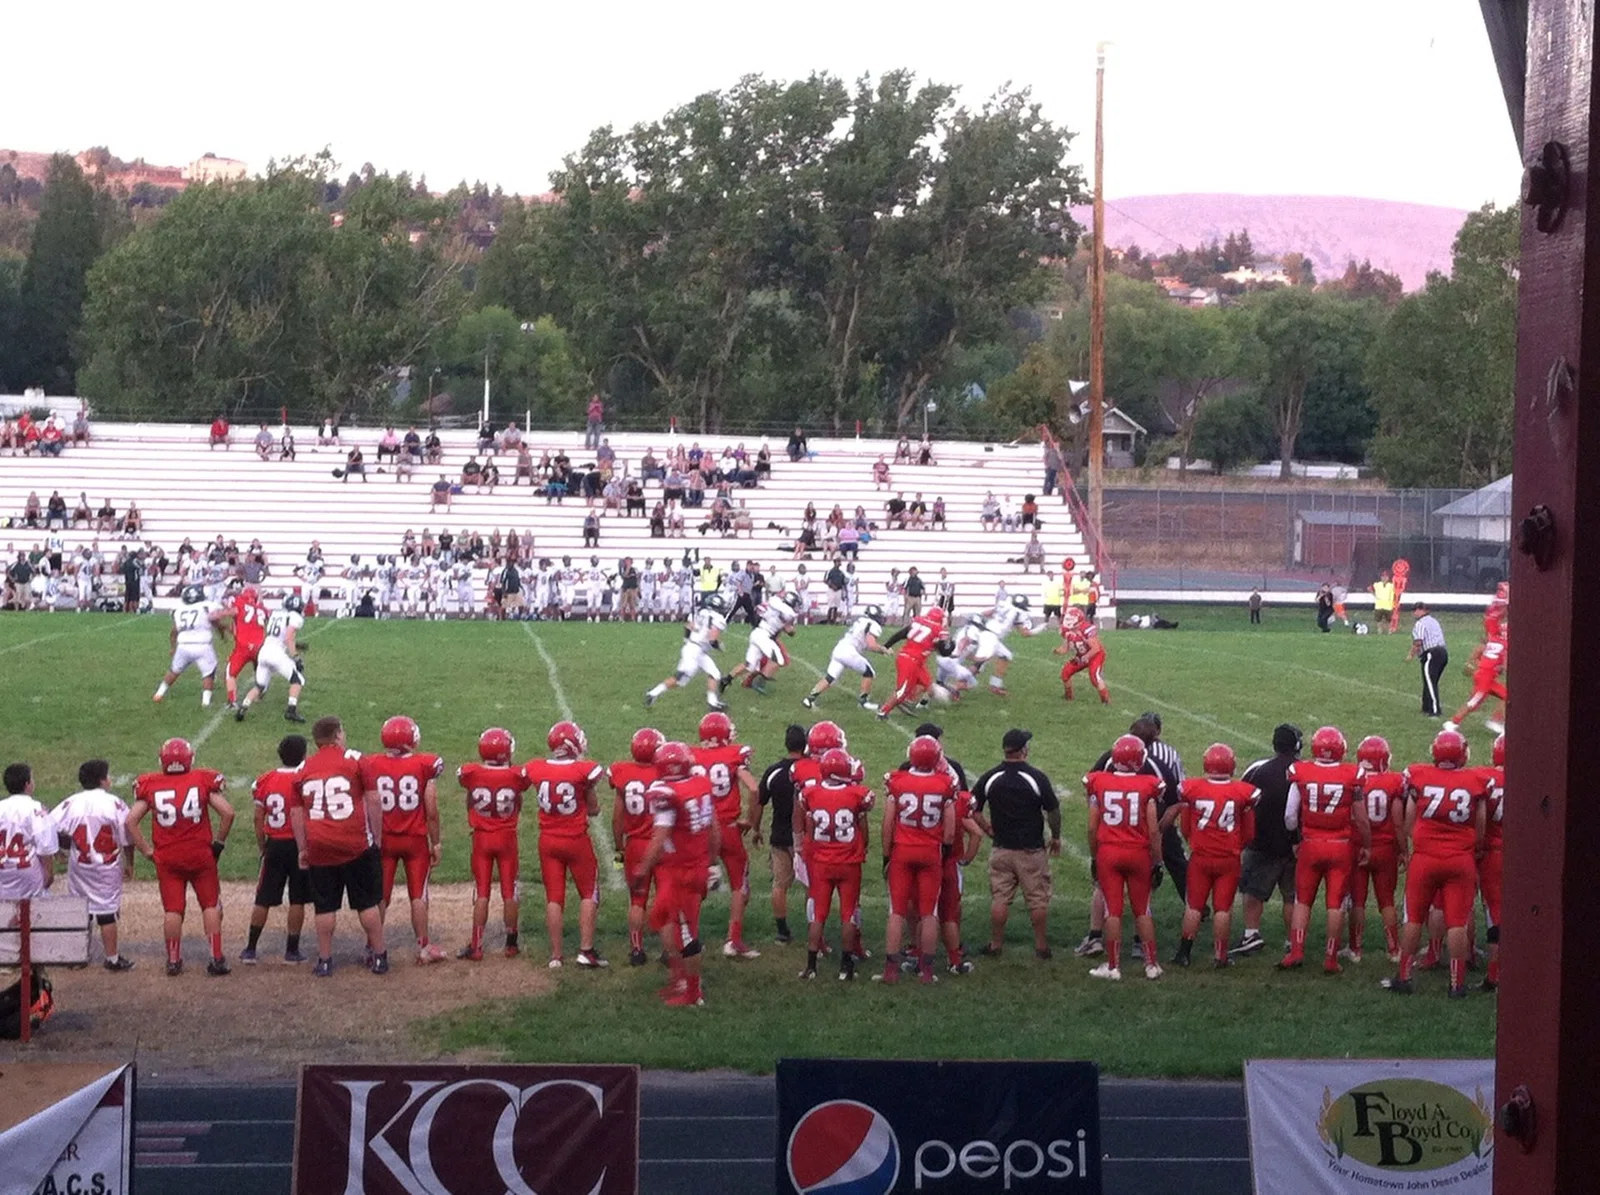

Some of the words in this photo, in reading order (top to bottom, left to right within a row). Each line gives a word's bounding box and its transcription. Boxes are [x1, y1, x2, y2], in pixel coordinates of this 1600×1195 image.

[180, 609, 199, 632] 57
[154, 787, 201, 827] 54
[302, 776, 355, 820] 76
[377, 775, 419, 811] 68
[538, 781, 577, 815] 43
[898, 793, 942, 828] 25
[1103, 791, 1140, 826] 51
[1306, 784, 1344, 814] 17
[1423, 786, 1471, 823] 73
[266, 794, 286, 829] 3
[812, 809, 855, 842] 28
[1195, 800, 1235, 832] 74
[332, 1078, 607, 1195] KCC
[914, 1129, 1087, 1189] pepsi
[1328, 1159, 1351, 1178] Your
[1351, 1171, 1405, 1190] Hometown
[1406, 1181, 1430, 1190] John
[1431, 1173, 1460, 1189] Deere
[1460, 1162, 1489, 1181] Dealer
